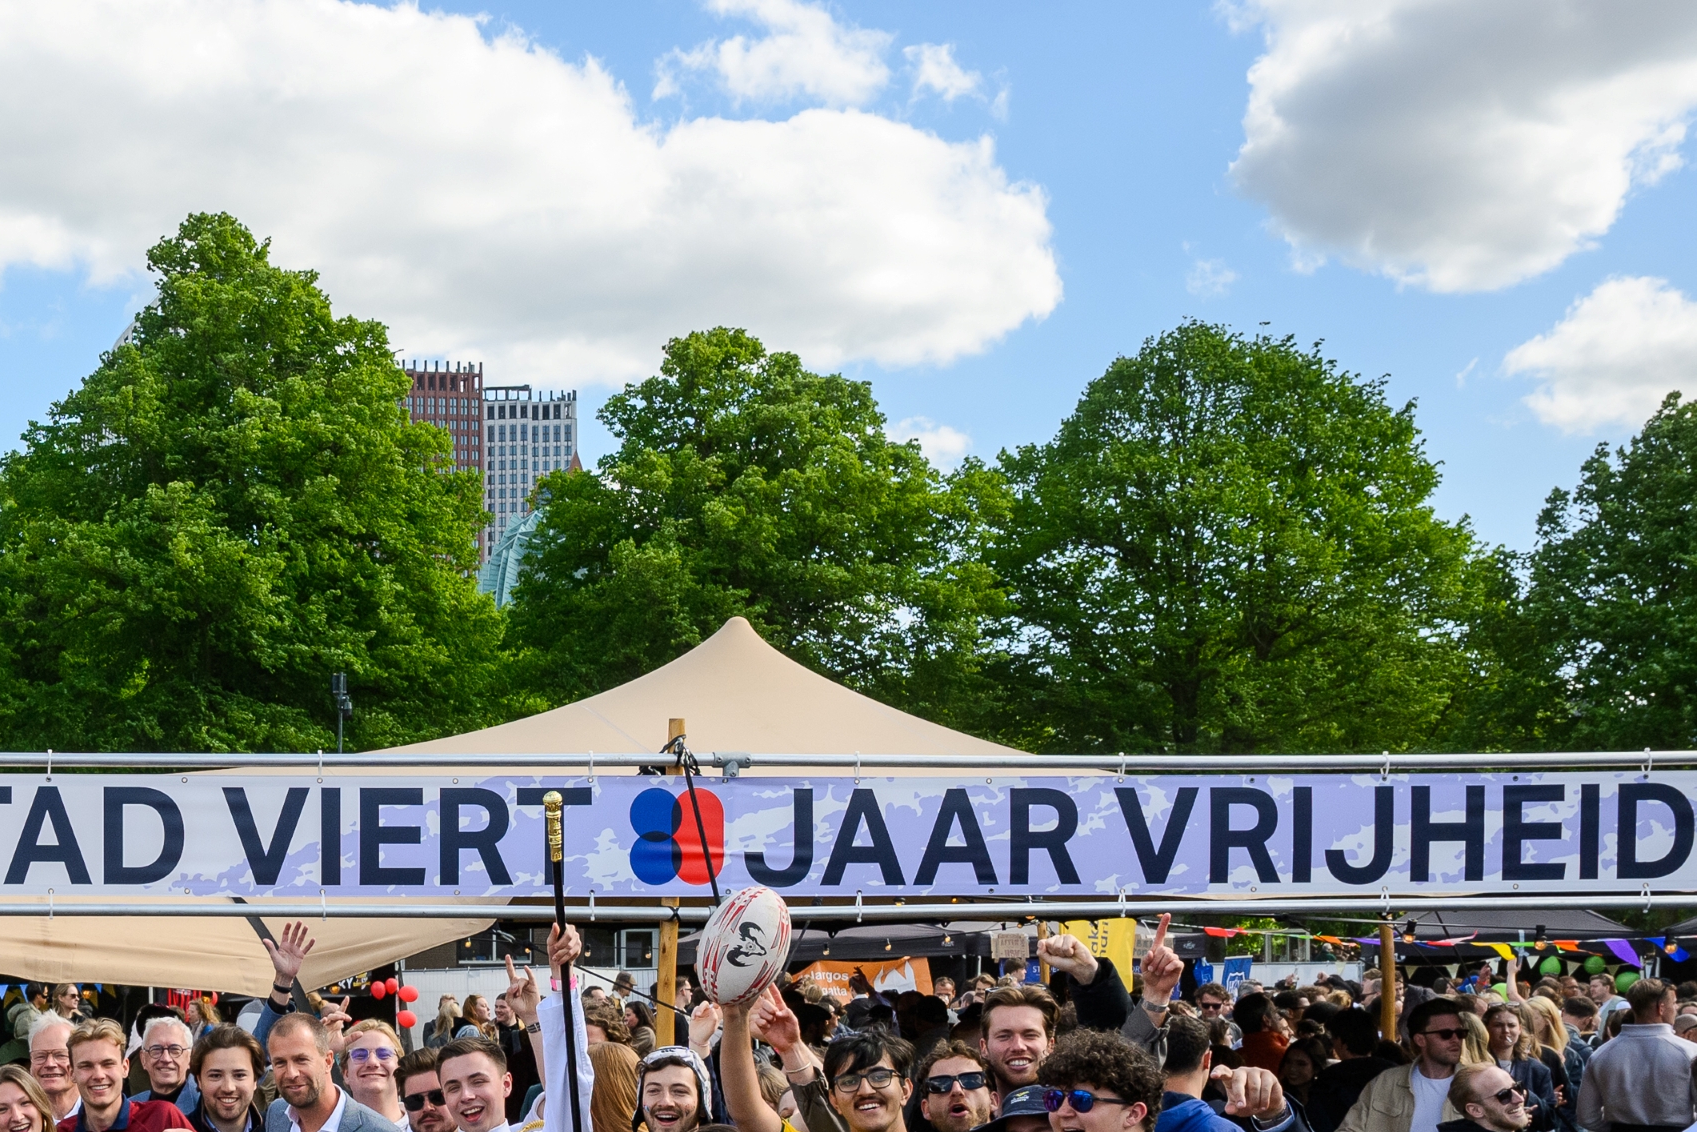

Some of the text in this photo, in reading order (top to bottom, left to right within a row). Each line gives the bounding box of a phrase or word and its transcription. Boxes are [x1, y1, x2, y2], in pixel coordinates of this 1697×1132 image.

[221, 787, 593, 886] VIERT
[745, 788, 1081, 888] JAAR
[1114, 783, 1695, 885] VRIJHEID
